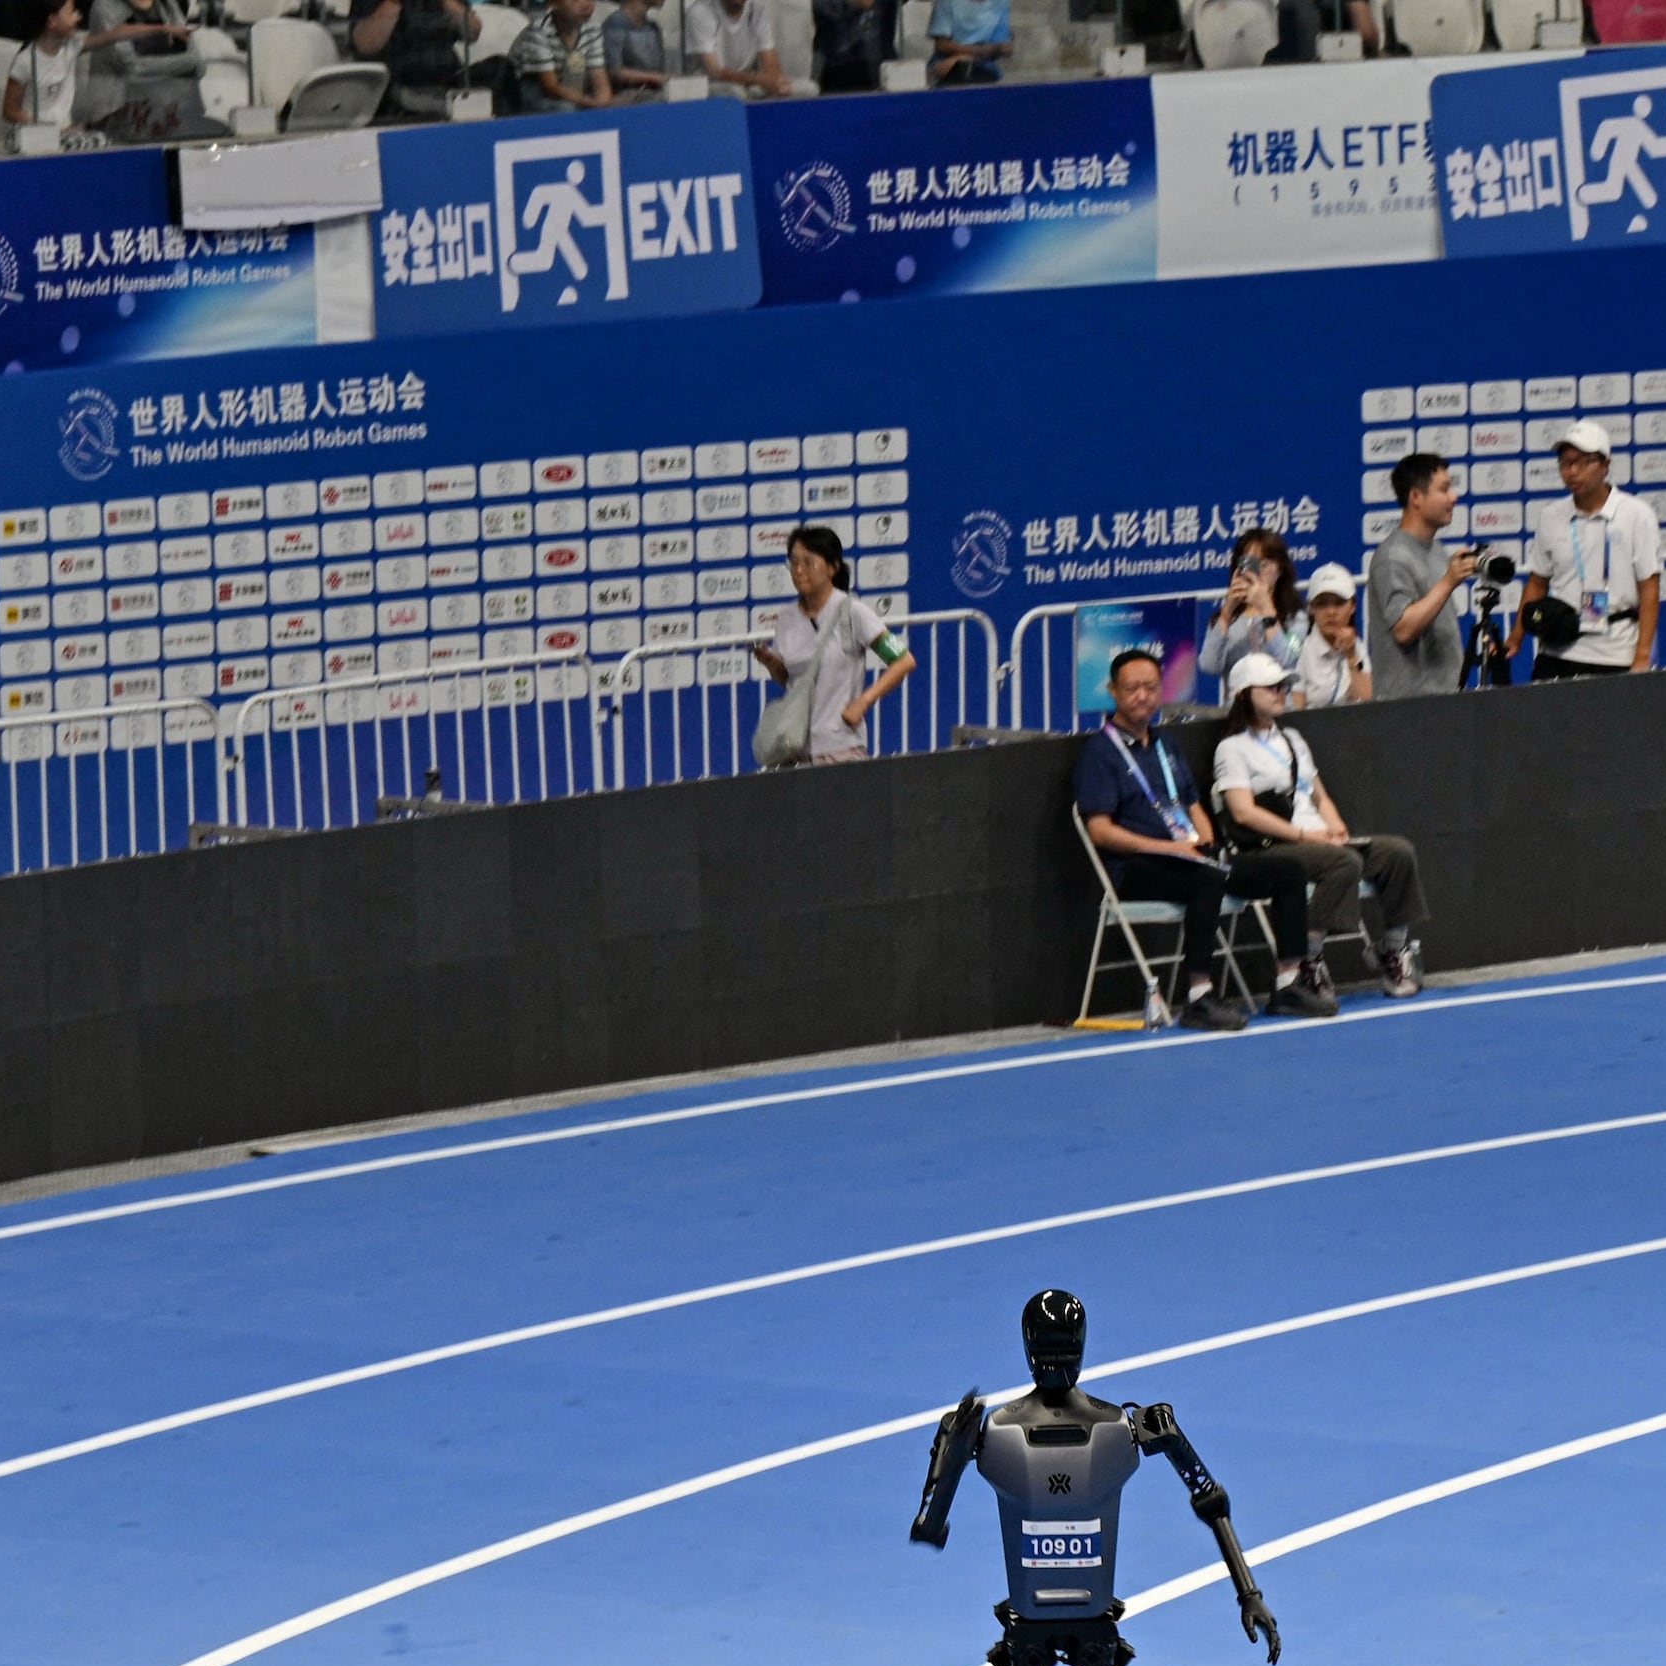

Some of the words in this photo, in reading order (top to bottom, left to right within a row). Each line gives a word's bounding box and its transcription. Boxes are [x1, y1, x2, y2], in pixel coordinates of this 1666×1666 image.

[866, 152, 1130, 205] 世界人形机器人运动会
[1447, 134, 1565, 219] 安全出口
[628, 174, 743, 262] EXIT
[867, 213, 897, 233] The
[899, 209, 945, 232] World
[948, 202, 1025, 227] Humanoid
[1029, 200, 1073, 220] Robot
[1078, 197, 1132, 216] Games
[33, 225, 289, 272] 世界人形机器人运动会
[381, 200, 494, 287] 安全出口
[35, 281, 62, 302] The
[66, 275, 110, 299] World
[113, 269, 189, 295] Humanoid
[192, 265, 237, 286] Robot
[240, 262, 291, 282] Games
[129, 370, 426, 437] 世界人形机器人运动会
[130, 445, 162, 467] The
[166, 438, 218, 464] World
[222, 428, 310, 458] Humanoid
[313, 425, 364, 449] Robot
[368, 421, 427, 443] Games
[1022, 495, 1320, 556] 世界人形机器人运动会
[1023, 564, 1055, 585] The
[1059, 558, 1110, 582] World
[1113, 552, 1200, 578] Humanoid
[1031, 1537, 1093, 1556] 10901
